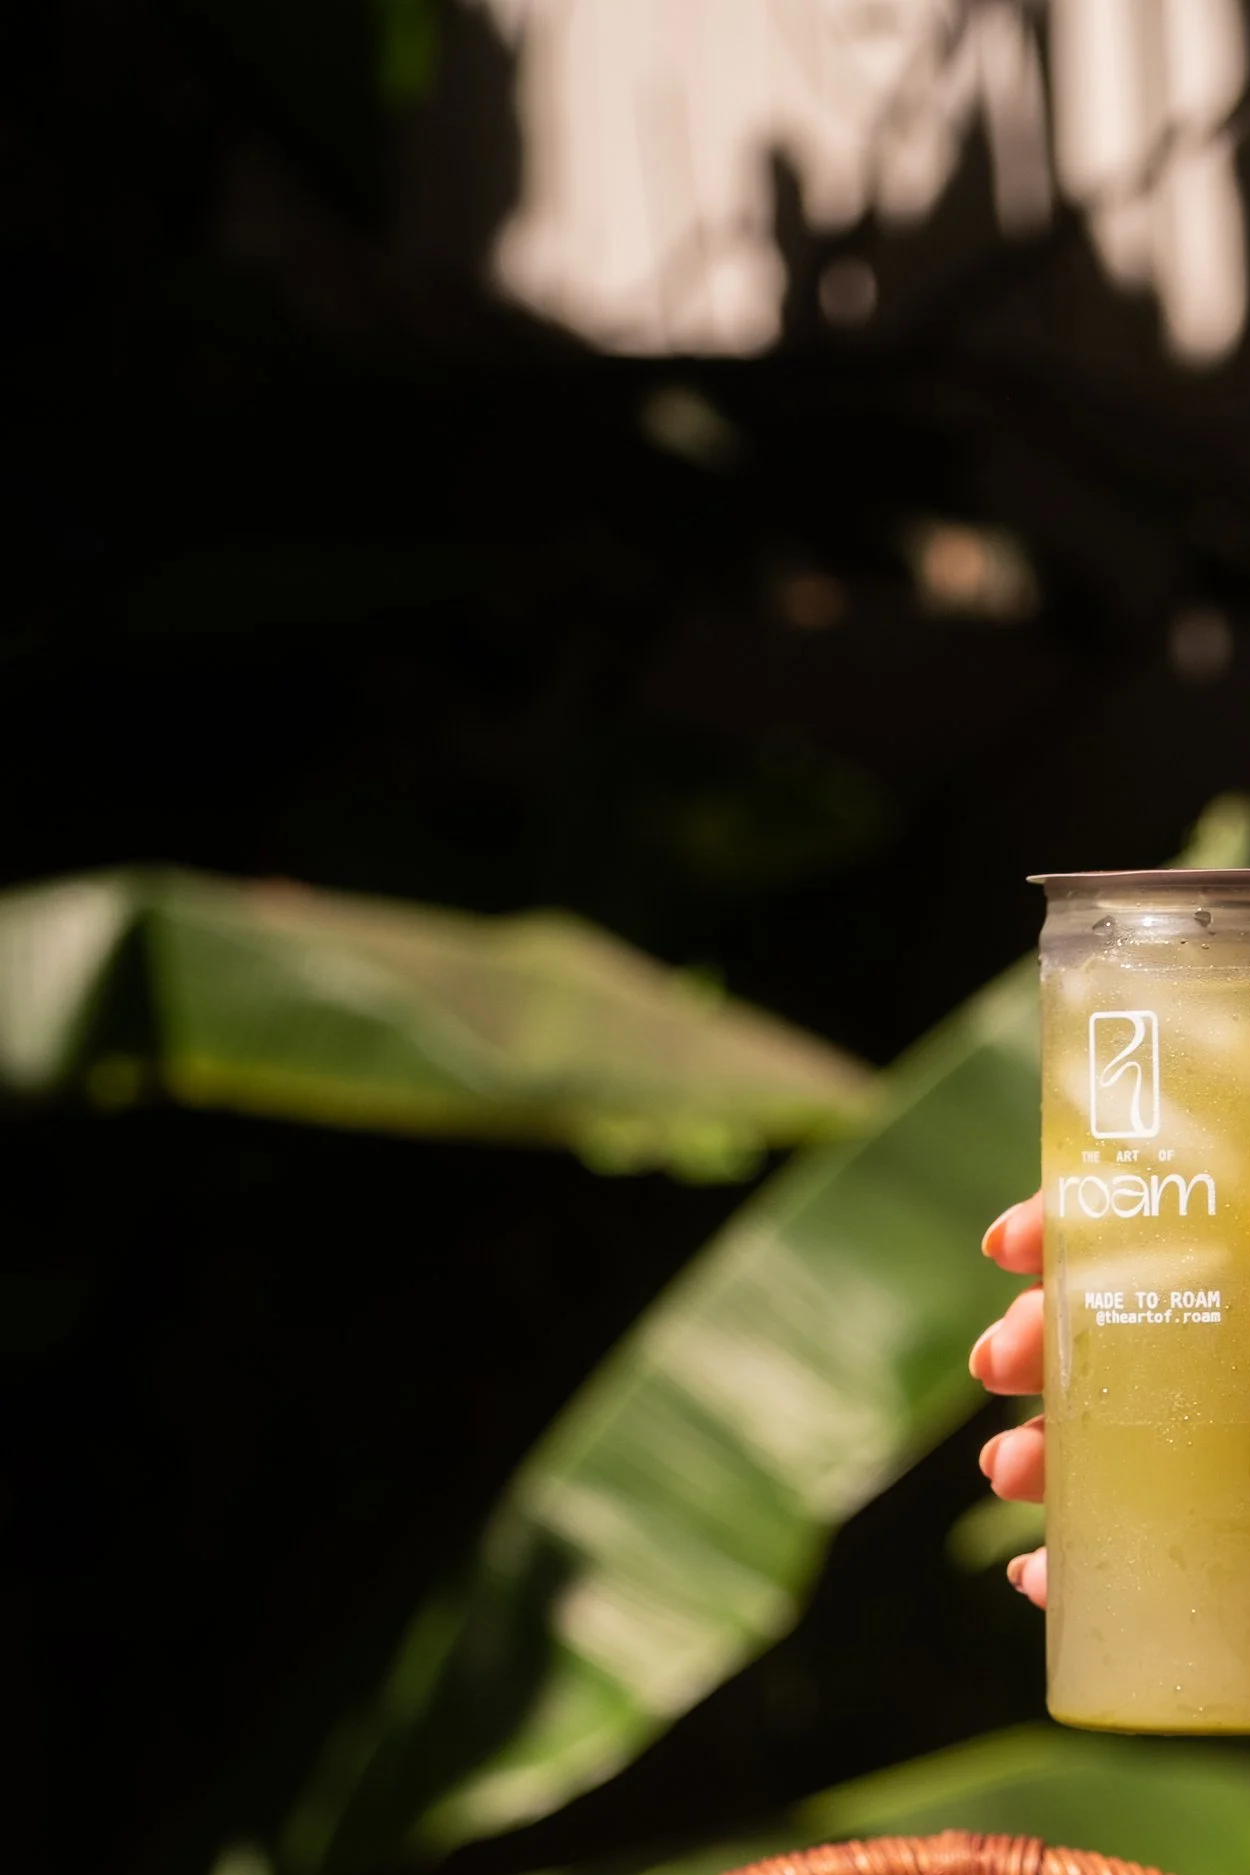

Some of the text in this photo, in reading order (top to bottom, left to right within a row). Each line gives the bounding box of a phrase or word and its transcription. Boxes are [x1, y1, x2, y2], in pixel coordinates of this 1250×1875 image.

[1082, 1150, 1174, 1163] THE ART OF
[1059, 1174, 1216, 1218] roam
[1085, 1291, 1221, 1309] MADE TO ROAM
[1096, 1310, 1221, 1326] @theartof.roam
